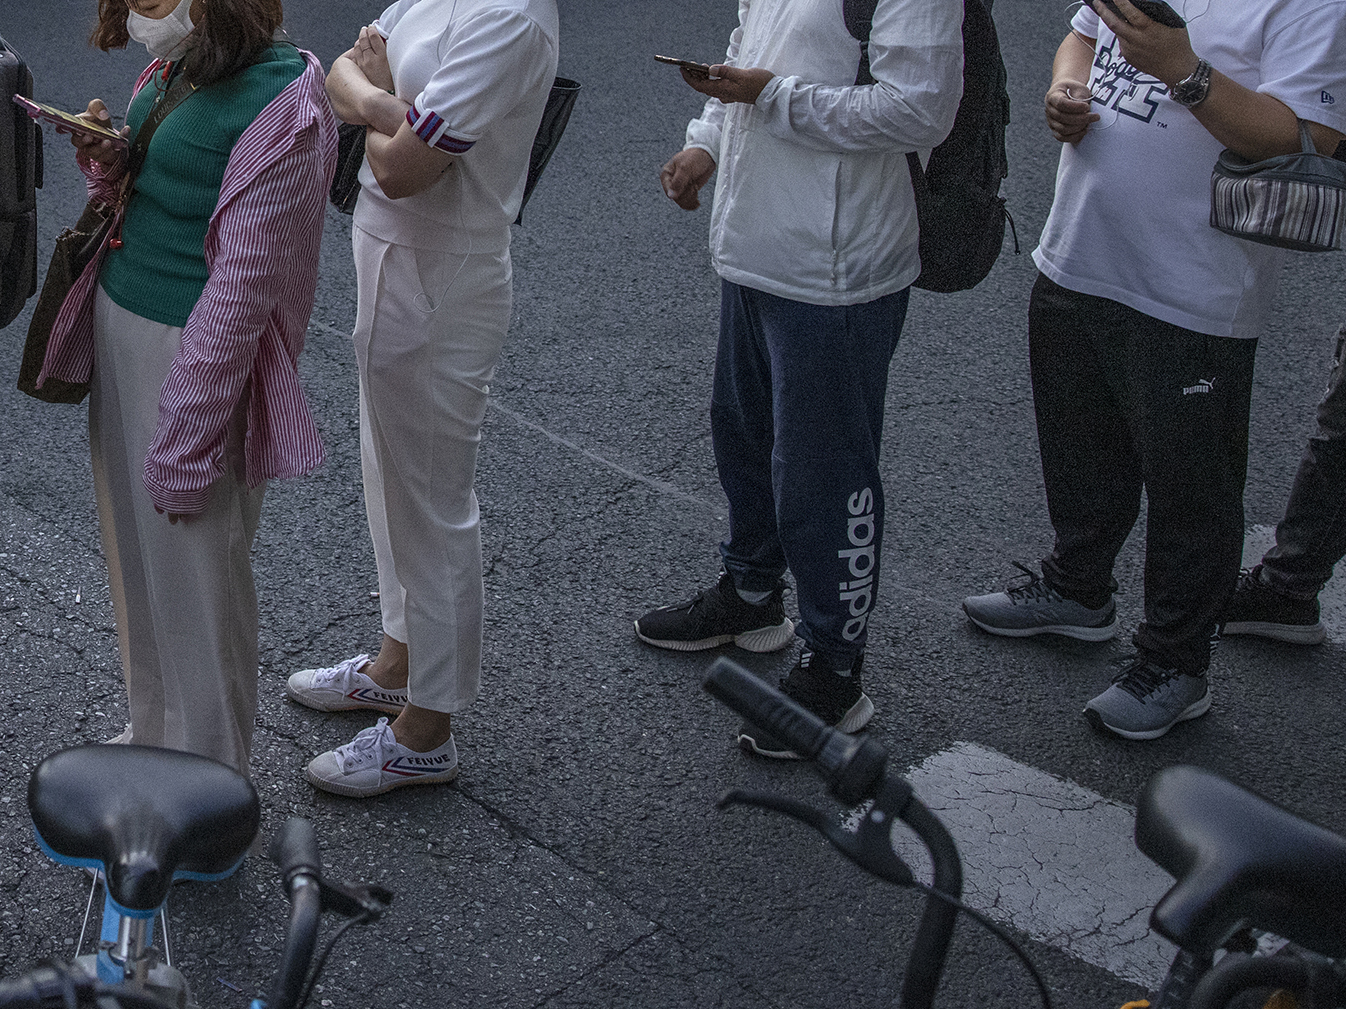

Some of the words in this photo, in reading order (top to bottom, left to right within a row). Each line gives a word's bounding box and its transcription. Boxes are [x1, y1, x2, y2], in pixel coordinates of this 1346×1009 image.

[1156, 121, 1168, 130] TM
[838, 487, 875, 641] adidas
[373, 691, 409, 704] FEIYU
[407, 753, 451, 766] FEIYUE
